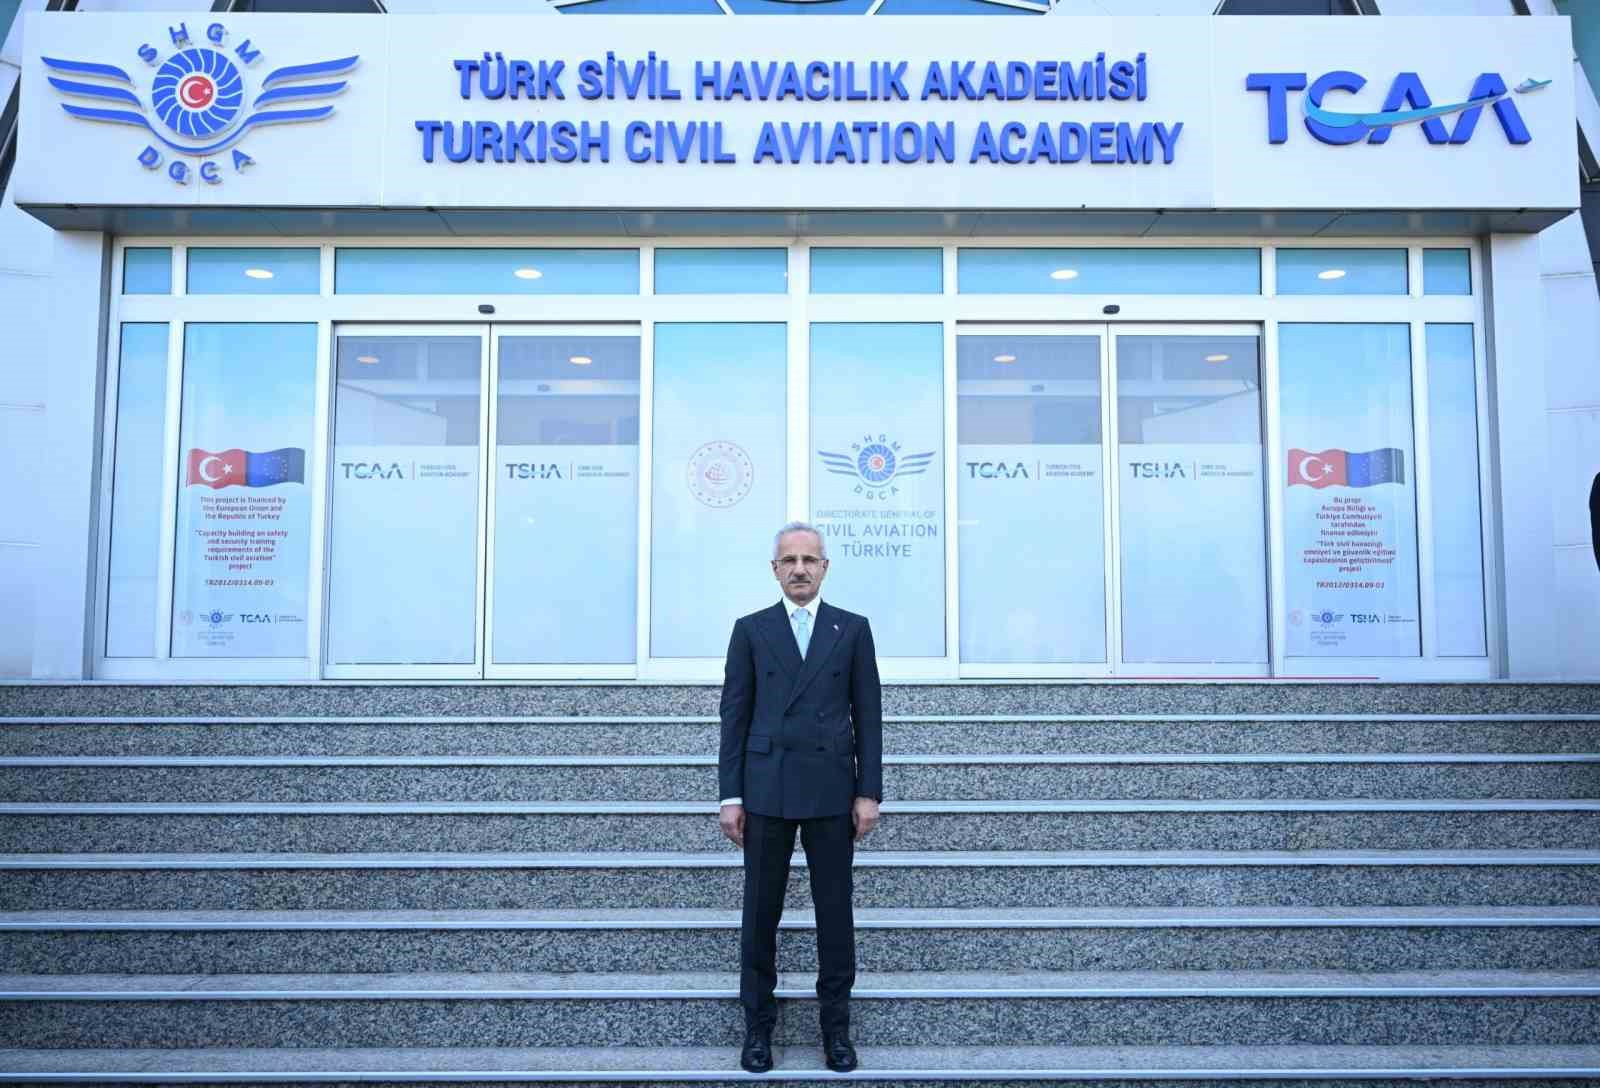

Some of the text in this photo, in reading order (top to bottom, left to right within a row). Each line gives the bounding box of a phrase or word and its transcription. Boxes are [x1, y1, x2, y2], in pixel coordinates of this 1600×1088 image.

[137, 22, 263, 67] SHGM
[454, 51, 1147, 100] TÜRK SİVİL HAVACILIK AKADEMİSİ
[1246, 70, 1533, 145] TCAA
[415, 120, 1184, 164] TURKISH CIVIL AVIATION ACADEMY
[137, 145, 255, 185] DGCA
[852, 434, 901, 452] SHGM
[341, 463, 404, 479] TCAA
[505, 463, 562, 479] TSHA
[966, 462, 1028, 478] TCAA
[1129, 462, 1186, 478] TSHA
[853, 484, 900, 500] DGCA
[258, 513, 280, 522] Turkey
[862, 524, 937, 536] AVIATION
[841, 540, 912, 557] TÜRKİYE
[240, 614, 271, 624] TCAA
